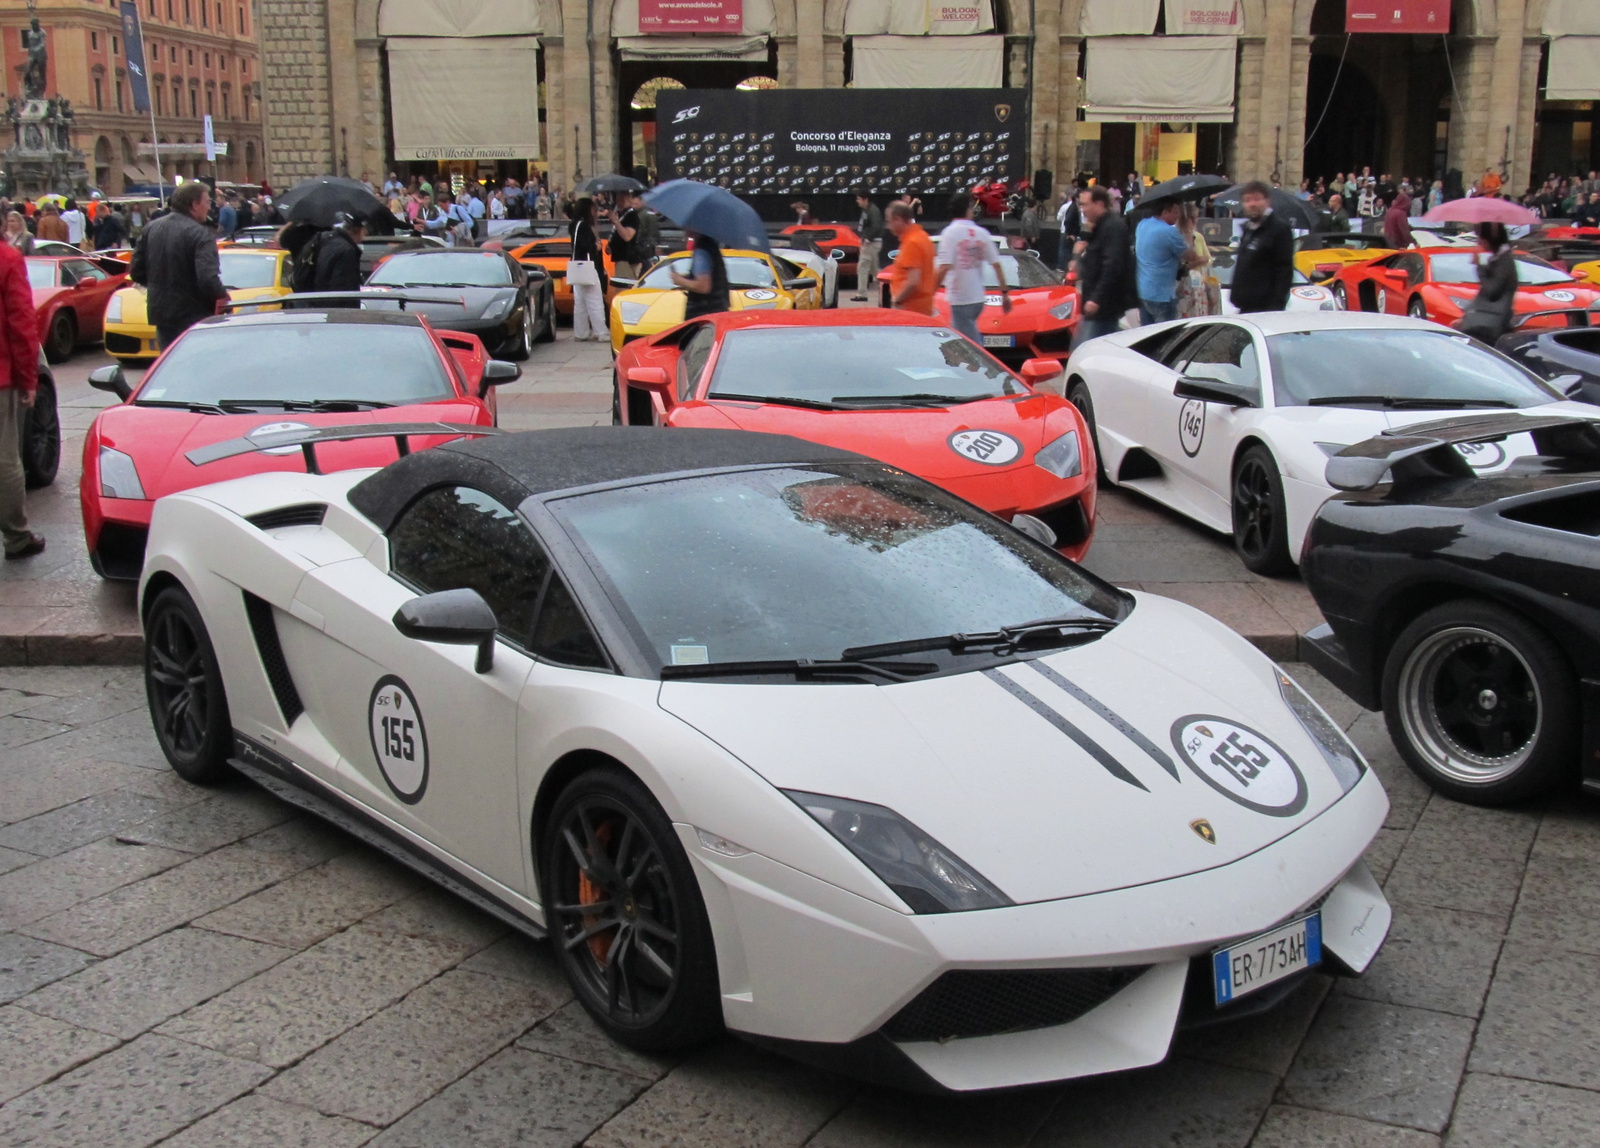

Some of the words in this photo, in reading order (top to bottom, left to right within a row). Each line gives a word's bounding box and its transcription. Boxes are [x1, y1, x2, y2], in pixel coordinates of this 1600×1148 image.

[790, 131, 836, 141] Concorso
[838, 131, 892, 143] d'Eleganza
[795, 144, 828, 153] Bologna,
[838, 144, 866, 153] maggio
[1183, 411, 1202, 438] 146
[966, 432, 1003, 460] 200
[382, 716, 415, 762] 155
[1209, 731, 1271, 788] 155
[1232, 953, 1253, 988] ER
[1257, 931, 1307, 979] 773AH
